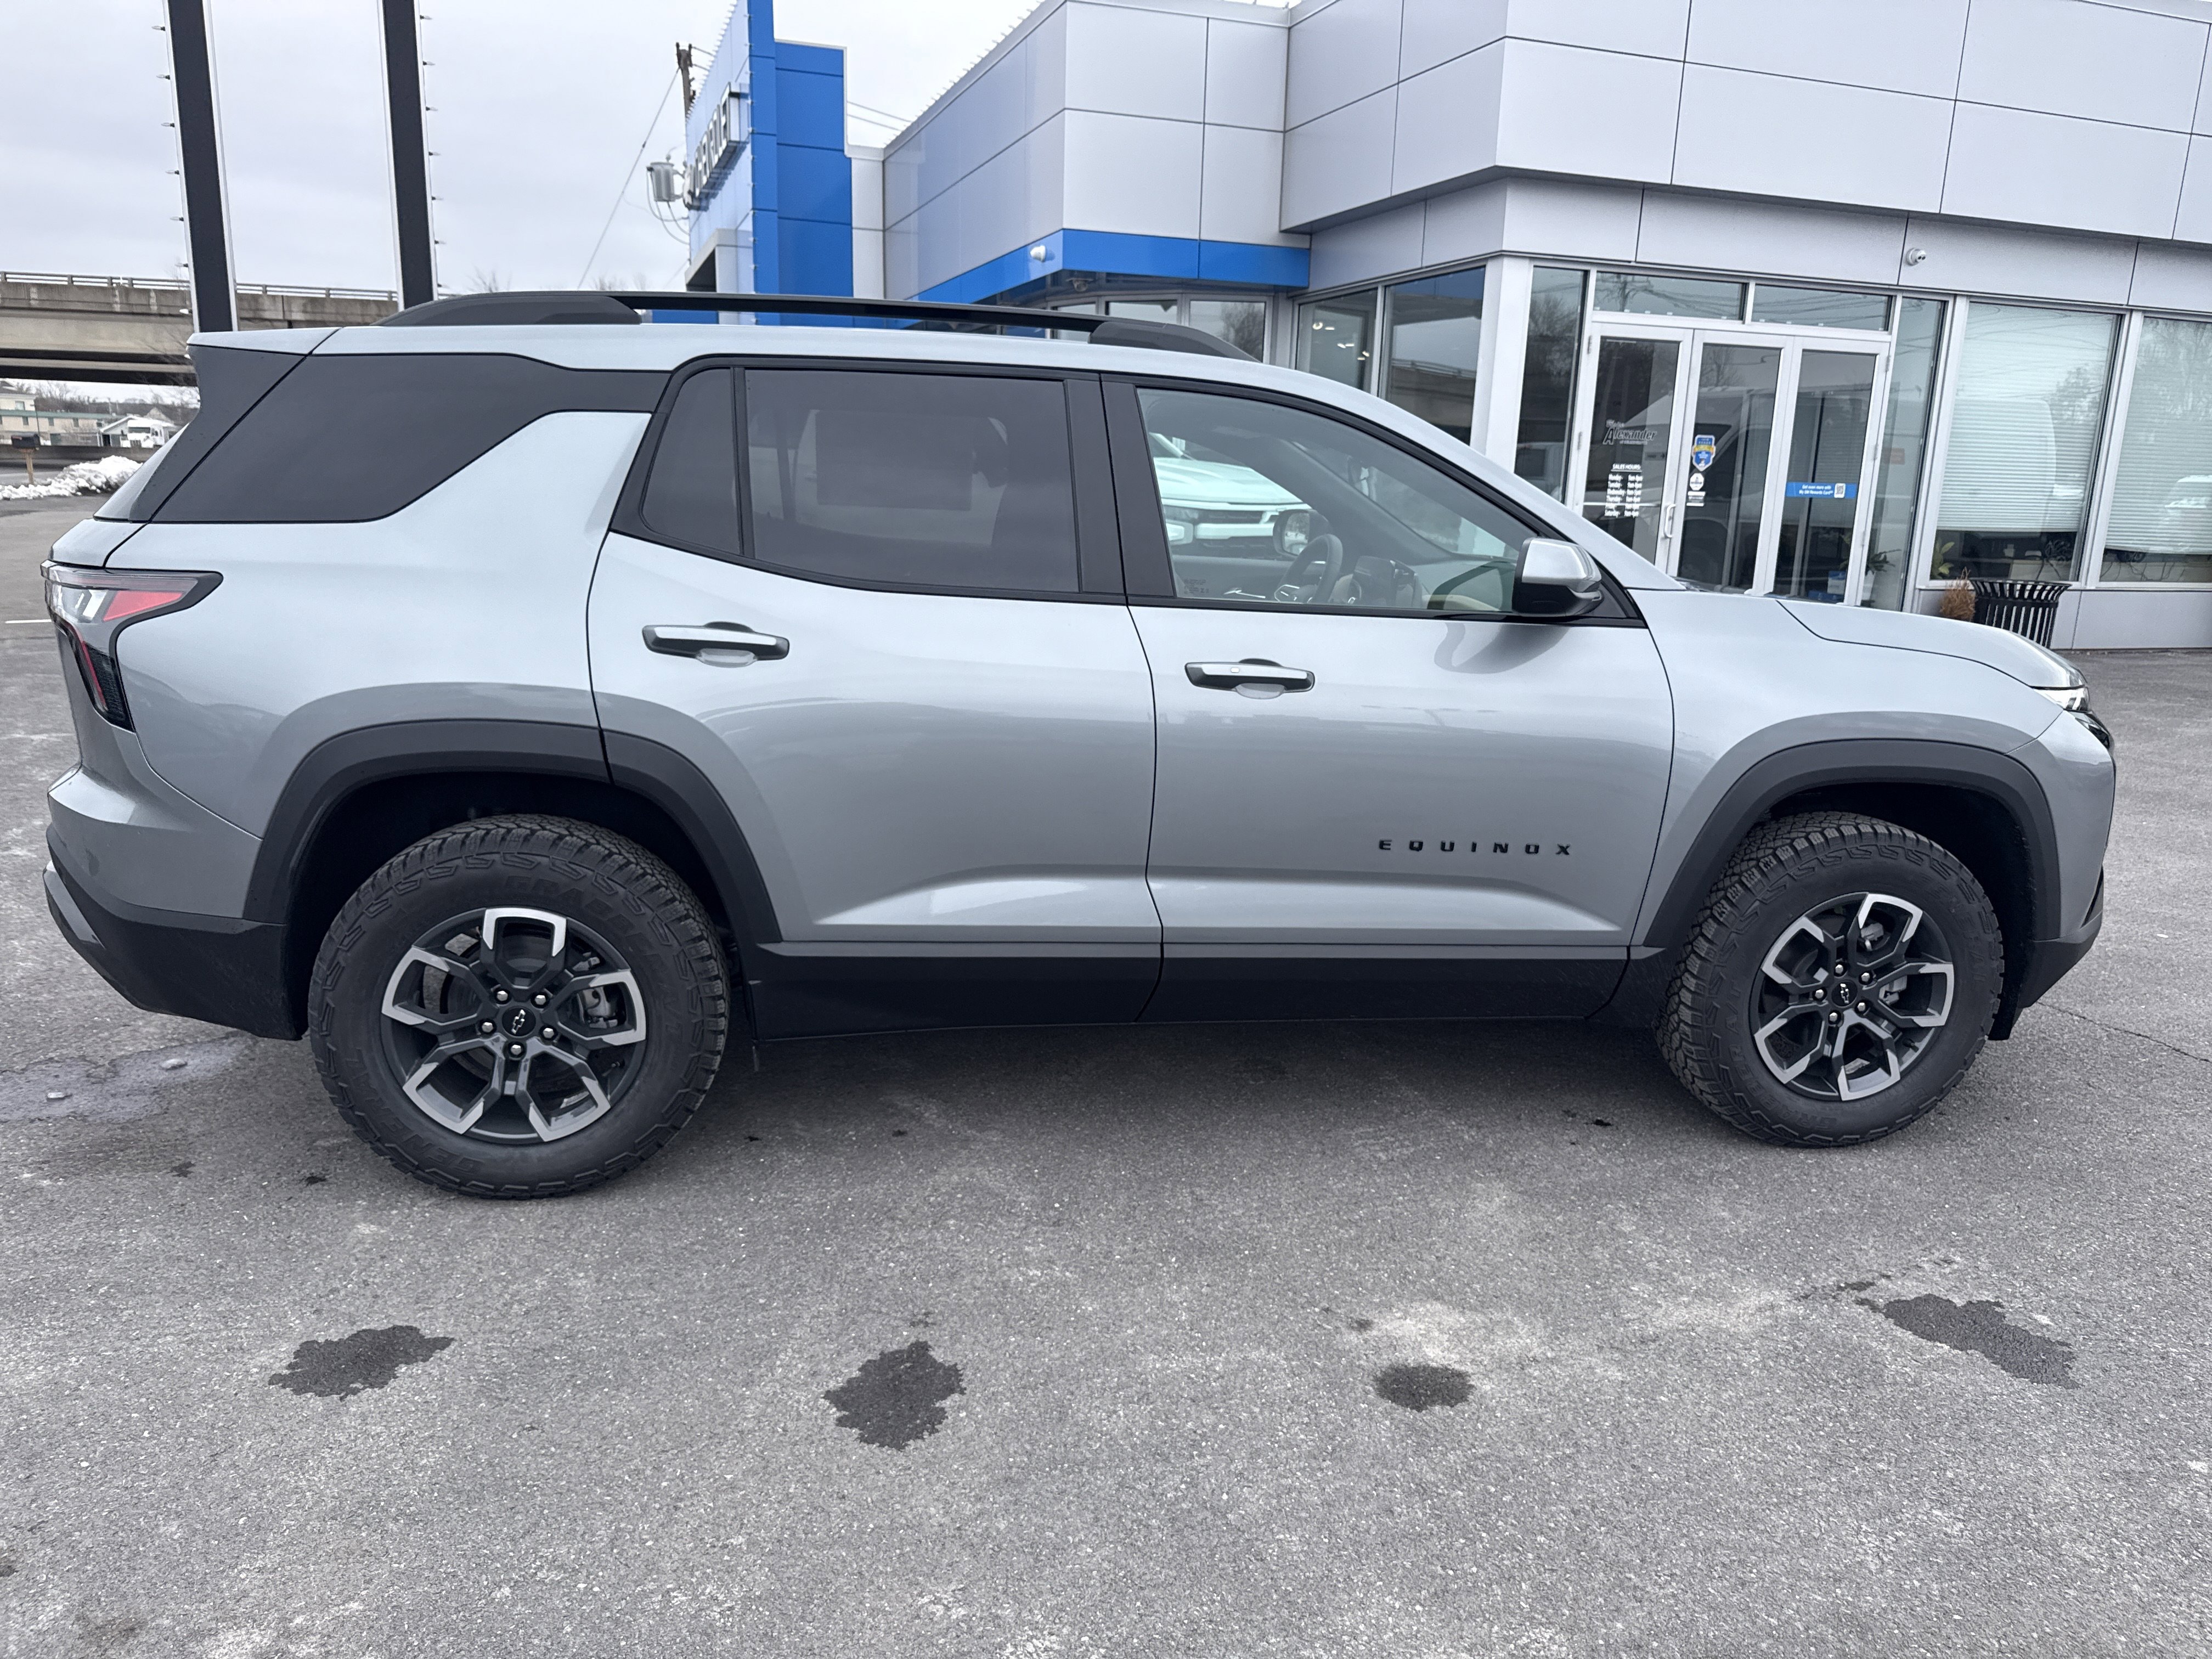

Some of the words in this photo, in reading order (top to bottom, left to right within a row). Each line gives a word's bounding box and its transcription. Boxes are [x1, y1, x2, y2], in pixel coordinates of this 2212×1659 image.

[1602, 427, 1657, 445] Alexander
[1378, 839, 1571, 856] EQUINOX
[505, 874, 670, 975] GRABBER
[346, 1047, 486, 1175] GENERAL
[1729, 1043, 1839, 1130] GRABBER
